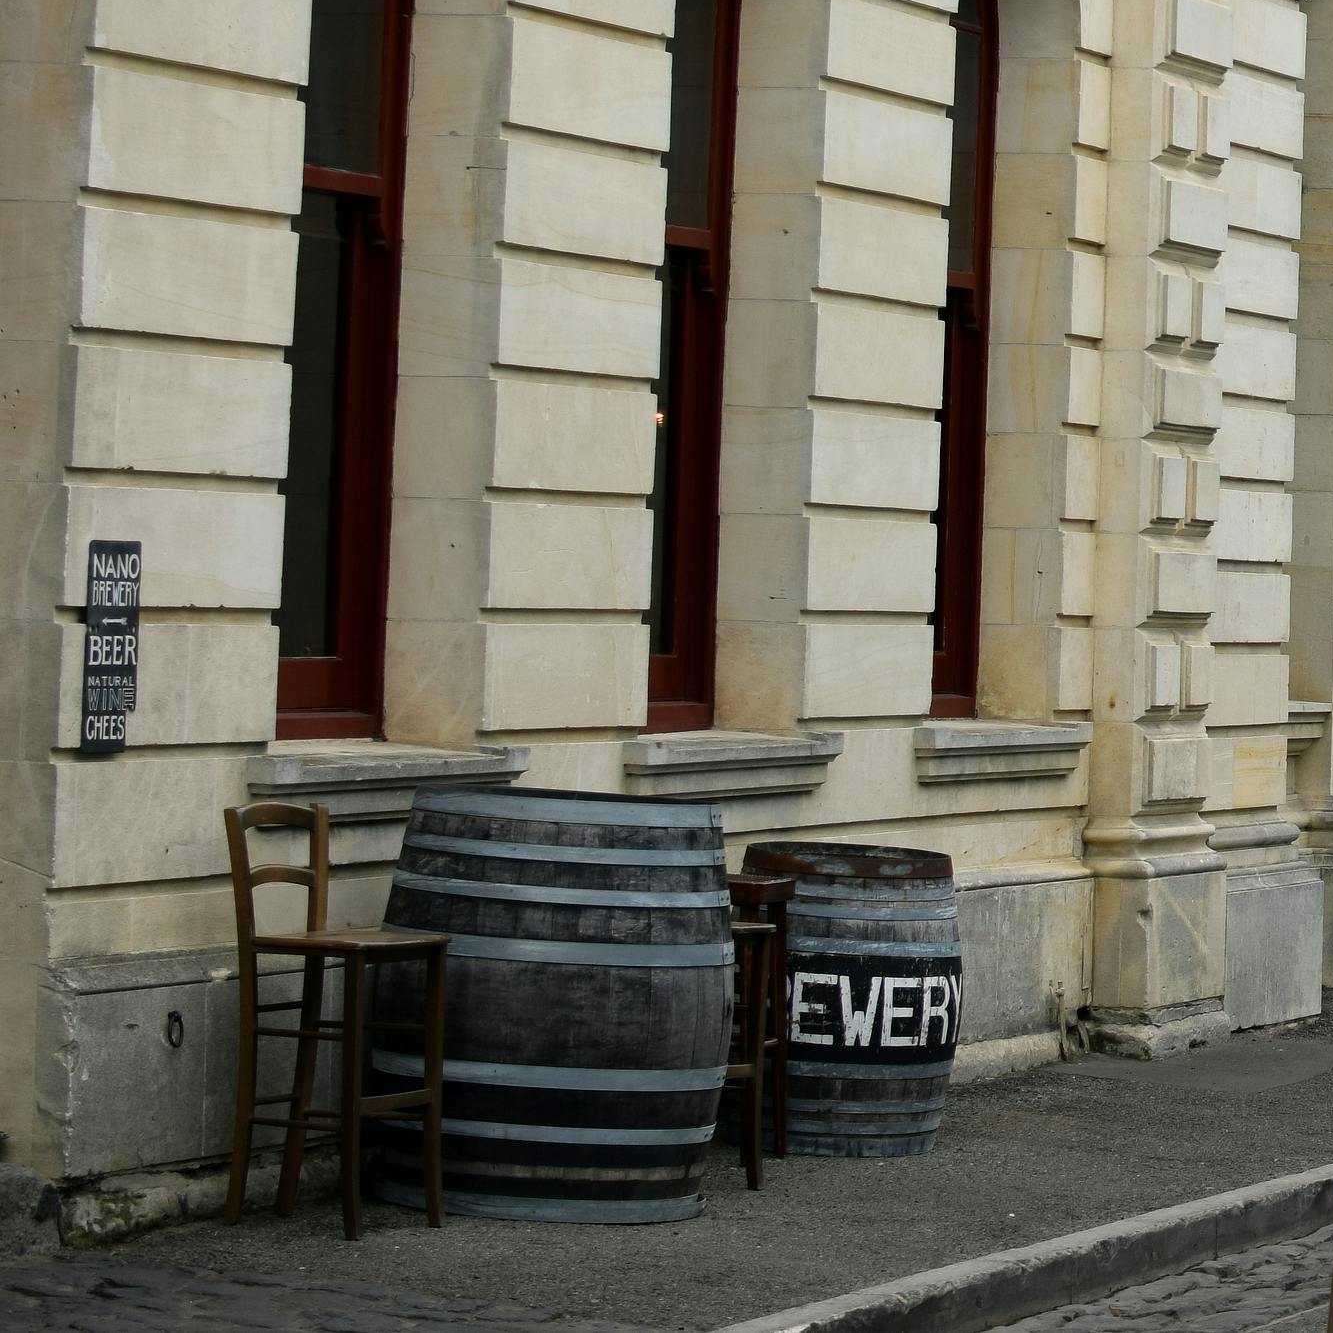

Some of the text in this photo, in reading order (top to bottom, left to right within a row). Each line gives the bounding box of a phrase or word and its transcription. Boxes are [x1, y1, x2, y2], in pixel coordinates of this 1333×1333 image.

[92, 553, 141, 579] NANO
[91, 581, 140, 607] BREWERY
[88, 634, 137, 666] BEER
[88, 675, 135, 687] NATURAL
[87, 688, 134, 711] WINE
[86, 715, 125, 740] CHEES
